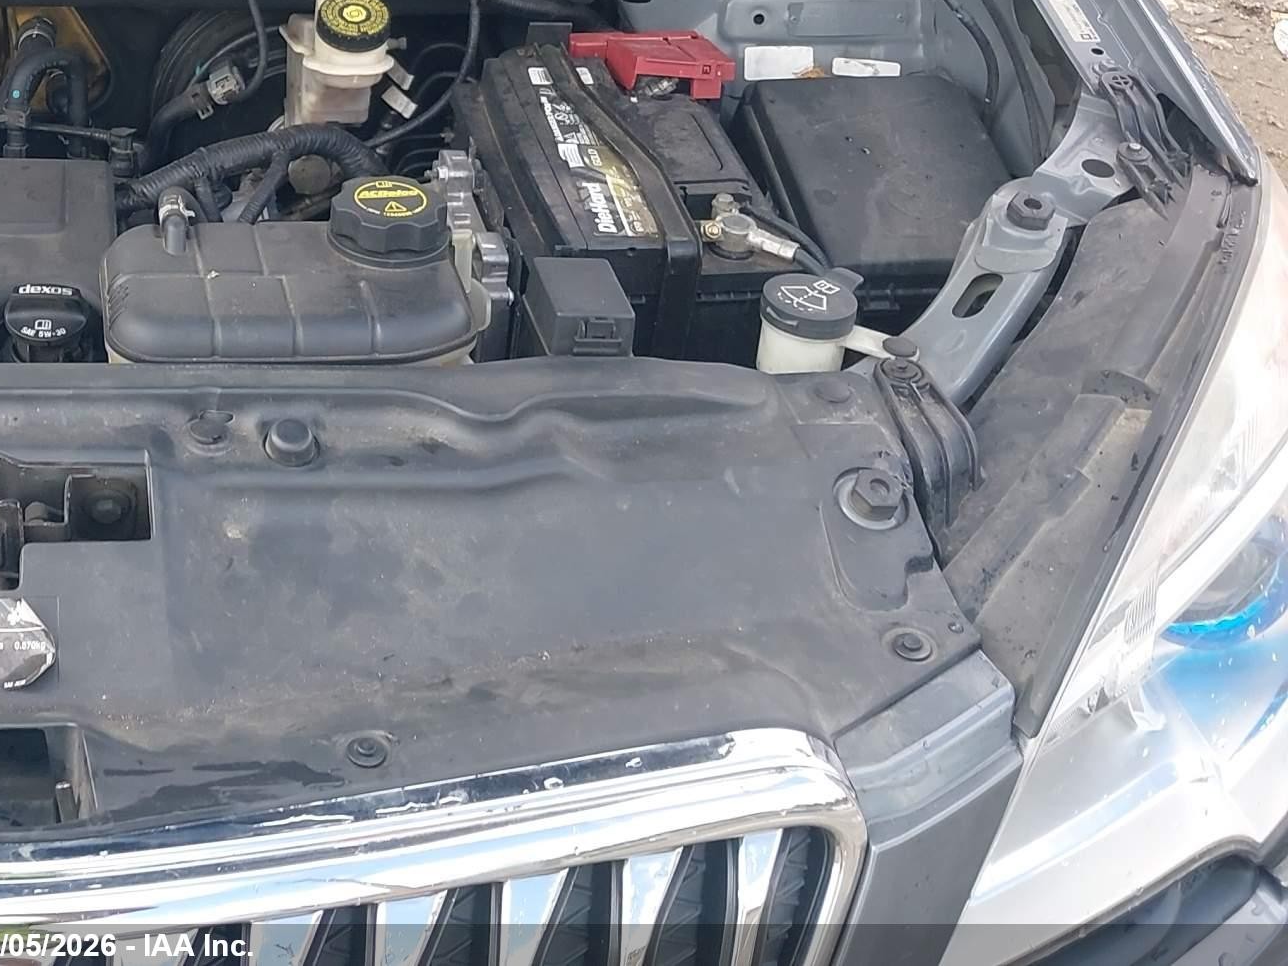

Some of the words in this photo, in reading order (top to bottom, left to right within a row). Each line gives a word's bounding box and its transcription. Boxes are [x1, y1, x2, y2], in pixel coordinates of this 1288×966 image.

[582, 183, 617, 233] DieHard
[18, 284, 73, 296] dexos
[20, 326, 37, 337] SAE
[38, 327, 66, 338] 5W-30
